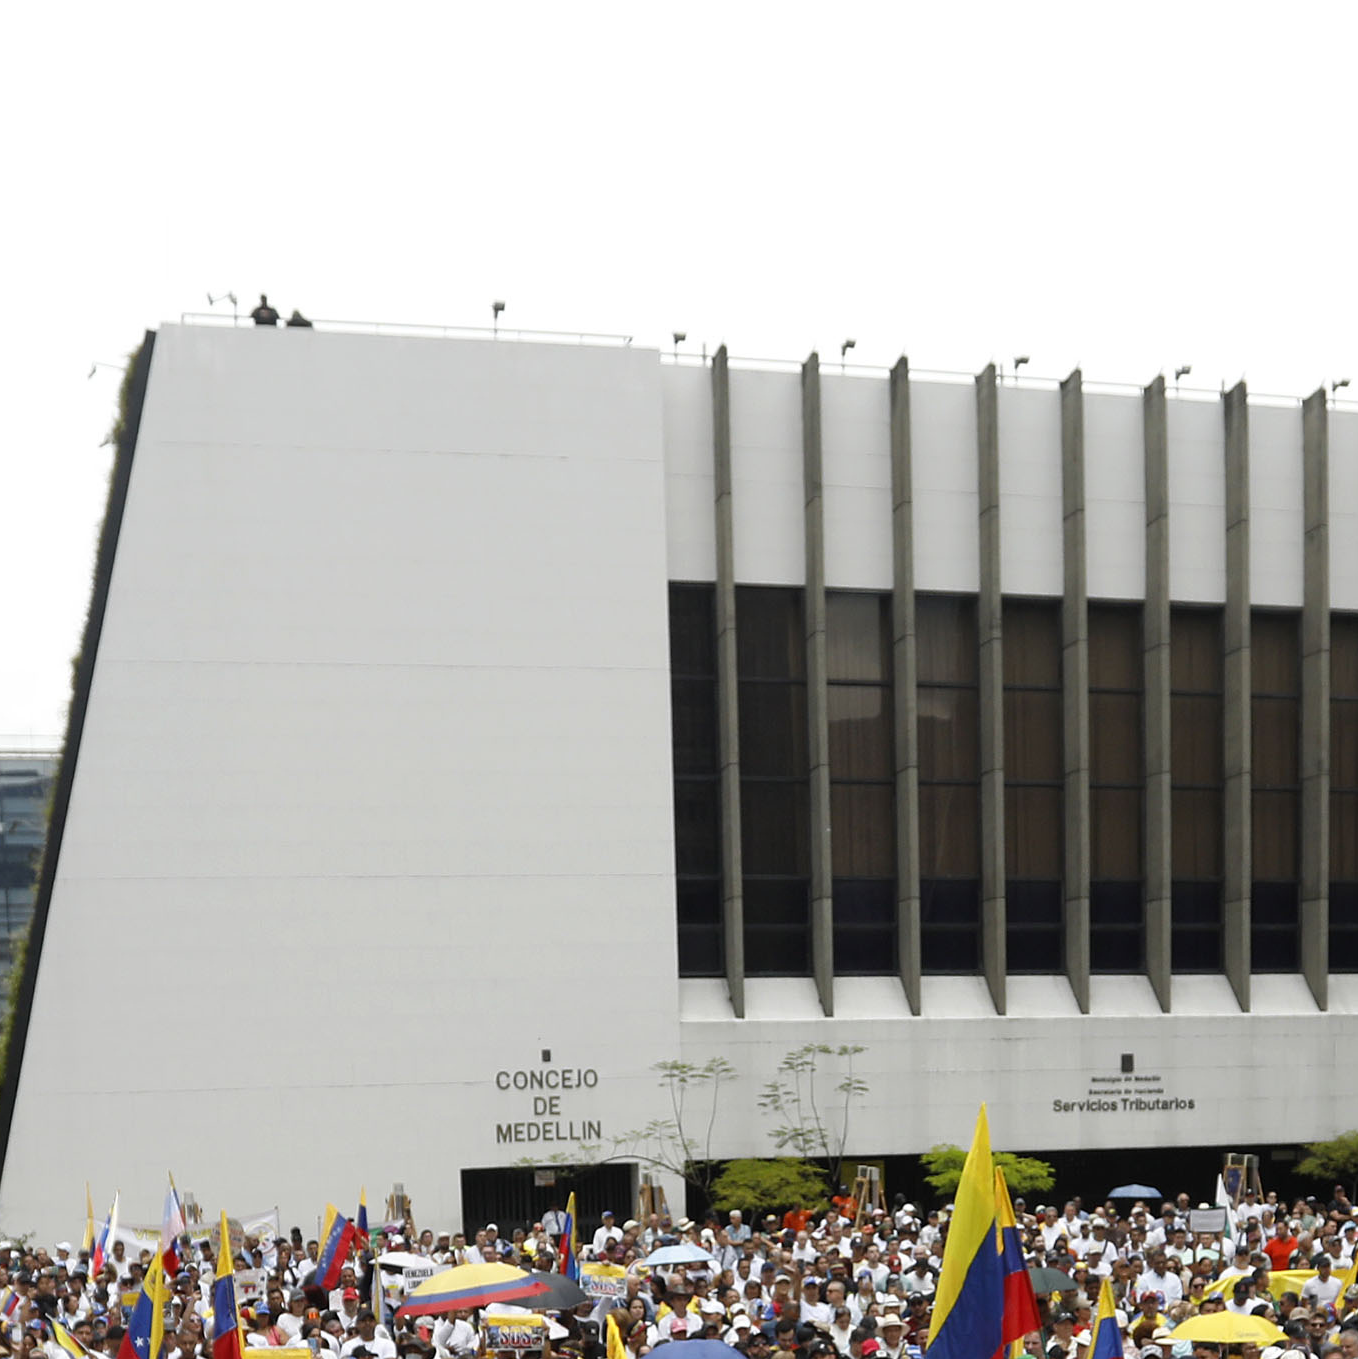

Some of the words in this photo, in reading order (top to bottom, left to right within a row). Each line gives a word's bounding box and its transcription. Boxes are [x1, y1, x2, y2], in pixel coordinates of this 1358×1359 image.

[496, 1069, 598, 1090] CONCEJO
[534, 1096, 561, 1116] DE
[1053, 1099, 1118, 1112] Servicios
[1121, 1098, 1195, 1111] Tributarios
[496, 1121, 601, 1143] MEDELLIN
[500, 1325, 533, 1347] SOS
